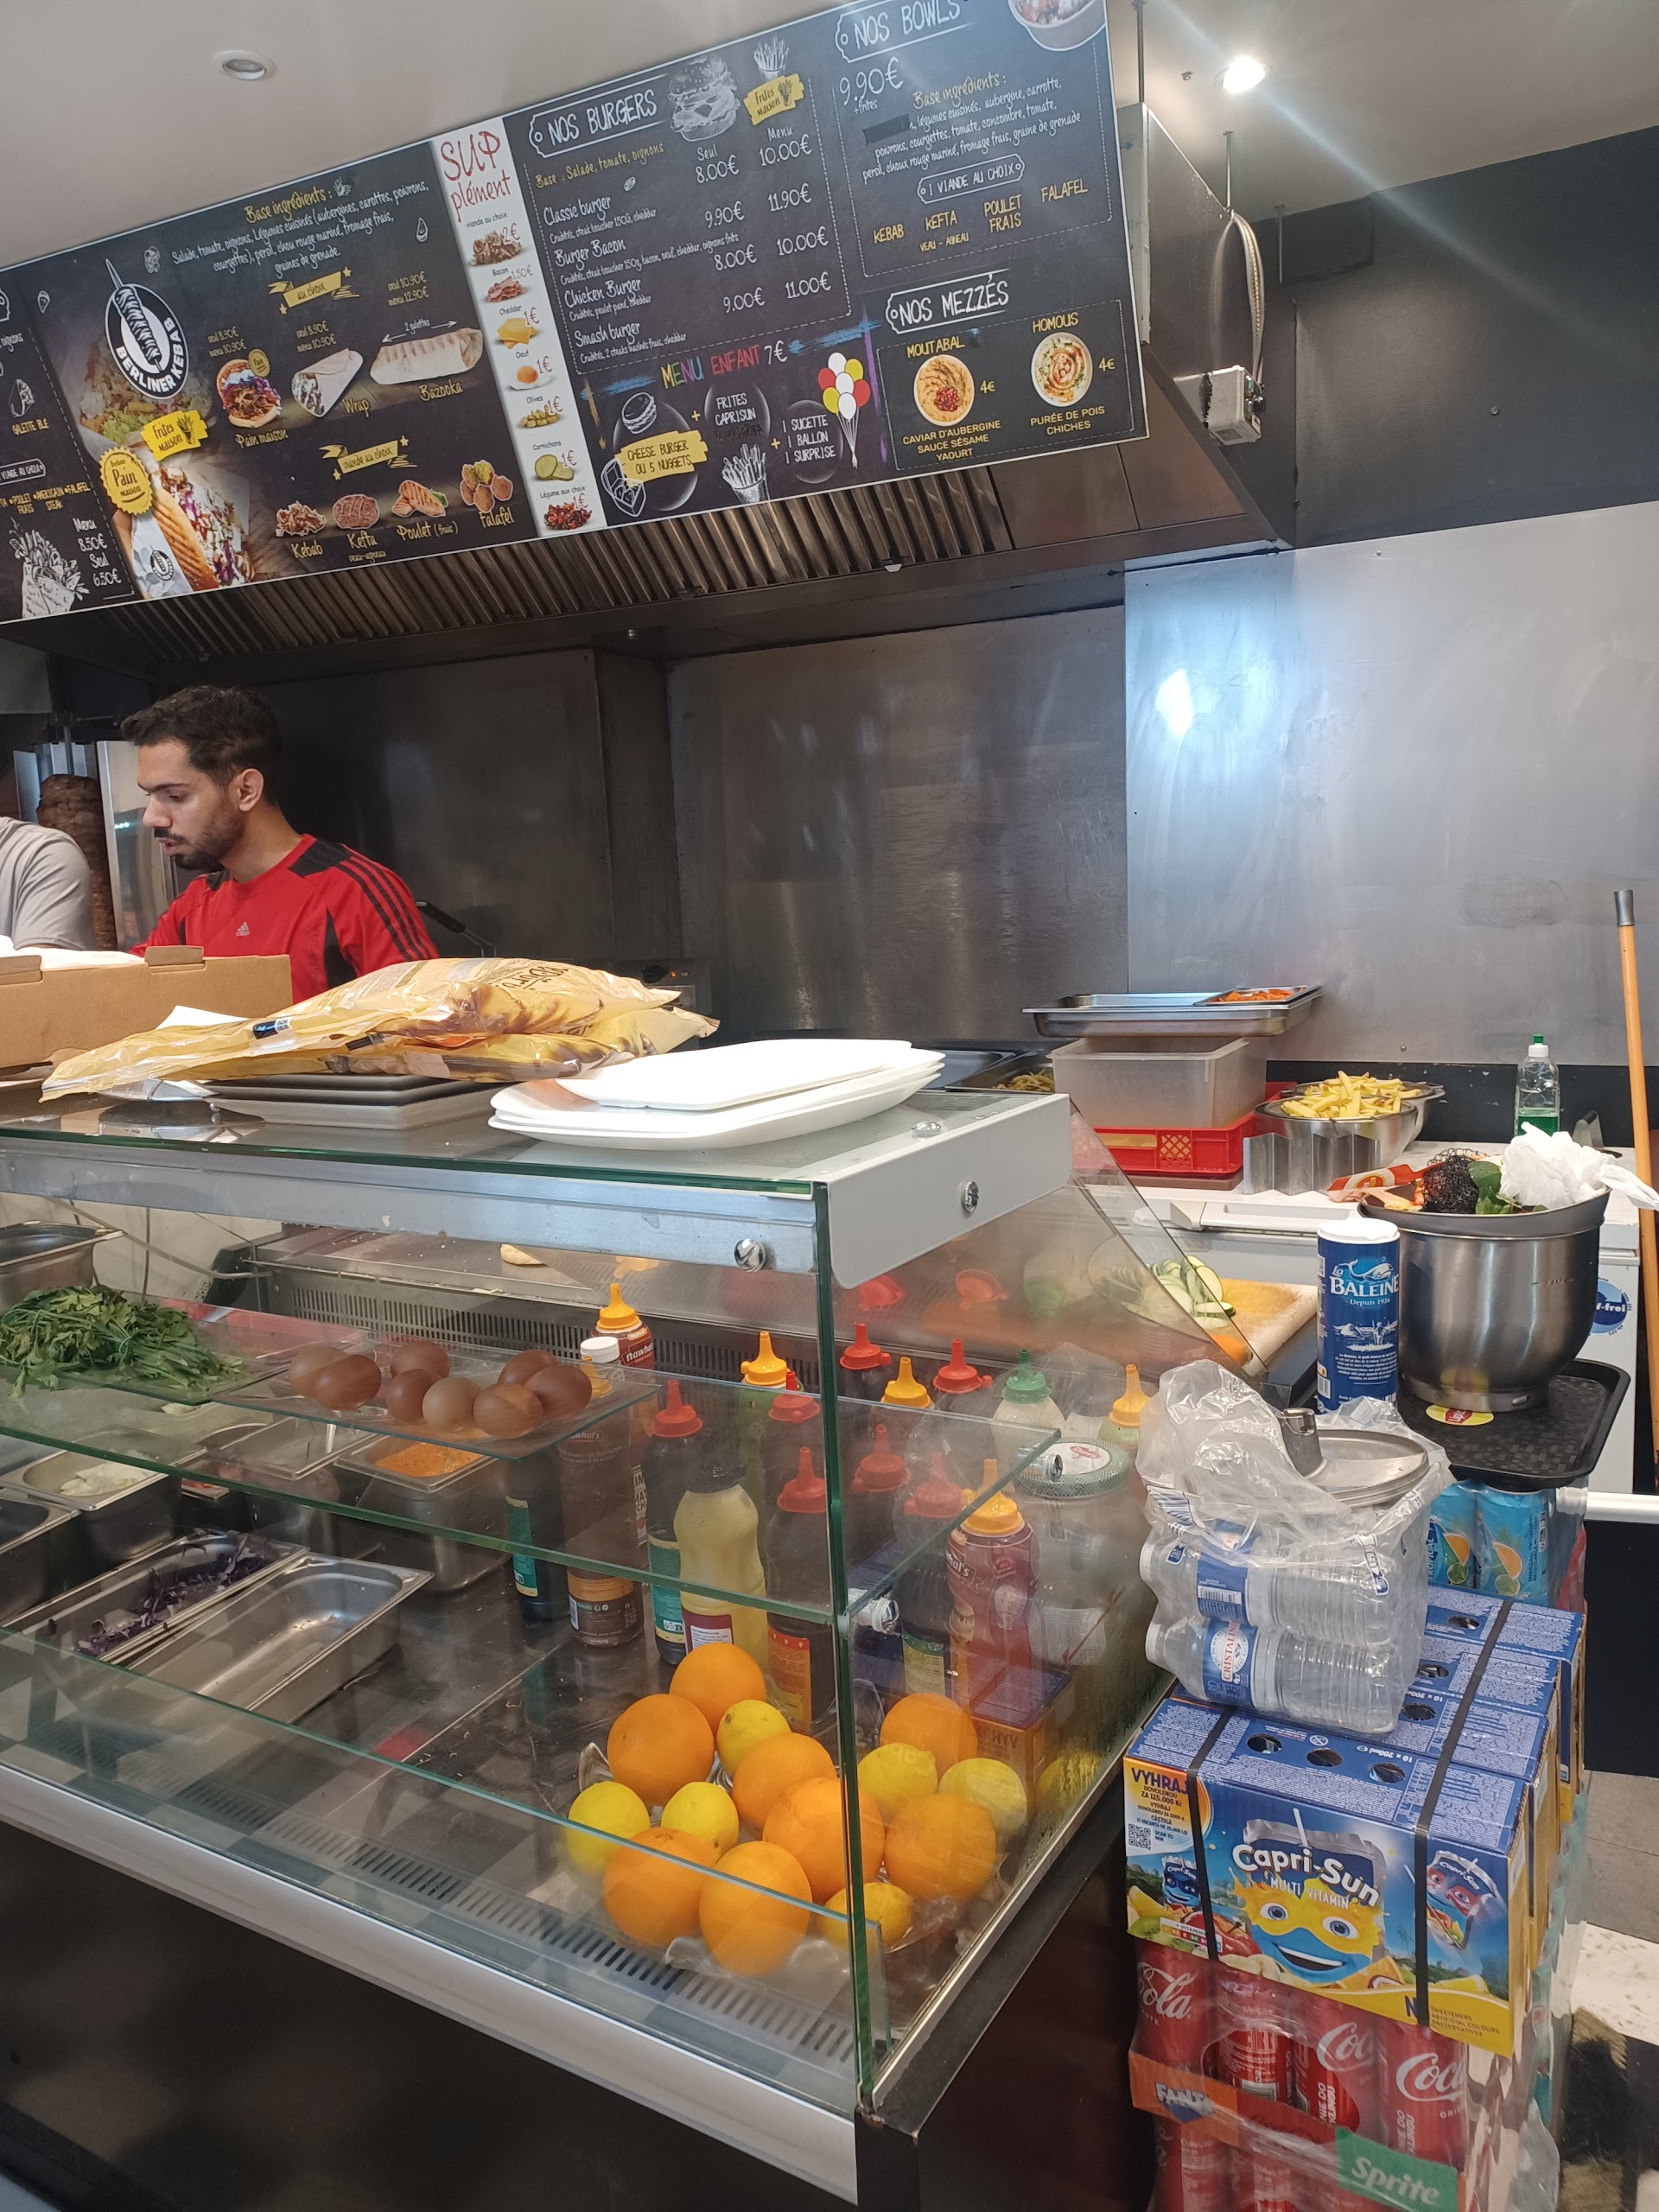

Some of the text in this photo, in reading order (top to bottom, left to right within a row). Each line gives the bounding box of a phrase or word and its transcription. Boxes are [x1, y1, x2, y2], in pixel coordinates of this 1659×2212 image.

[854, 0, 961, 50] NOS BOWLS
[840, 57, 904, 105] 9.90€
[912, 71, 1001, 109] Base ingrédients
[917, 110, 947, 133] légumes
[947, 99, 982, 118] cuisinés,
[985, 87, 1026, 110] aubergine,
[1027, 76, 1062, 96] carrotte,
[548, 89, 657, 145] NOS BURGERS
[909, 98, 1058, 152] courgettes, tomate, concombre, tomate,
[767, 127, 793, 142] Menu
[441, 131, 501, 181] SUP
[695, 133, 812, 183] 8.00€ 10.00€
[697, 143, 718, 162] Seul
[862, 111, 1081, 185] persil, choux rouge fromage frais, graine de grenade
[536, 143, 664, 188] Base Salade, tomate, oignons
[937, 162, 1014, 194] VIANDE AU CHOIX
[451, 169, 512, 223] plément
[1040, 178, 1089, 203] FALAFEL
[245, 186, 327, 223] Base ingrédients
[543, 195, 612, 226] Classic burger
[705, 182, 812, 228] 9.90€ 11.90€
[983, 194, 1022, 217] POULET
[467, 218, 485, 228] viande
[493, 211, 508, 221] choix
[925, 210, 957, 231] KEFTA
[989, 213, 1021, 233] FRAIS
[276, 218, 373, 252] chou rouge fromage
[503, 223, 521, 245] 2€
[874, 224, 905, 244] KEBAB
[172, 235, 254, 264] Salade, tomate, oignons,
[555, 237, 626, 271] Burger Bacon
[714, 226, 830, 271] 8.00€ 10.00€
[275, 253, 309, 279] graines de
[493, 266, 509, 276] Bacon
[307, 282, 328, 299] choix
[564, 278, 641, 308] Chicken Burger
[723, 270, 832, 314] 9.00€ 11.00€
[899, 273, 1009, 327] NOS MEZZÉS
[499, 306, 522, 316] Cheddar
[524, 307, 540, 326] 1€
[404, 321, 410, 332] 2
[1032, 311, 1078, 334] HOMOUS
[574, 321, 641, 347] Smash burger
[116, 316, 185, 392] BERLINER KEBAB
[906, 335, 965, 359] MOUTABAL
[537, 356, 553, 374] 1€
[660, 340, 788, 389] MENU ENFANT 7€
[1099, 358, 1116, 372] 4€
[419, 379, 463, 403] Bazooka
[980, 380, 995, 394] 4€
[343, 397, 370, 418] Wrap
[548, 396, 563, 415] 1€
[715, 392, 748, 411] FRITES
[715, 408, 757, 427] CAPRISUN
[791, 415, 828, 432] SUCETTE
[1030, 405, 1106, 427] PURÉE DE POIS
[154, 420, 175, 441] Frites
[902, 420, 1001, 446] CAVIAR D'AUBERGINE
[1046, 420, 1091, 435] CHICHES
[235, 428, 289, 449] Pain maison
[533, 440, 562, 451] Cornichons
[797, 430, 830, 448] BALLON
[918, 432, 989, 454] SAUCE SÉSAME
[374, 445, 394, 460] choix
[562, 449, 577, 467] 1€
[627, 440, 690, 463] CHEESE BURGER
[793, 446, 836, 463] SURPRISE
[936, 448, 974, 461] YAOURT
[636, 455, 691, 475] OU NUGGETS
[112, 467, 138, 487] Pain
[540, 489, 560, 499] Légume
[574, 493, 588, 510] 1€
[479, 506, 515, 529] Falafel
[347, 531, 378, 550] Kefta
[397, 522, 432, 541] Poulet
[290, 540, 323, 560] Kebab
[1331, 1265, 1344, 1277] La
[1329, 1274, 1400, 1297] BALEINE
[1350, 1298, 1376, 1308] Depuis
[1131, 1767, 1188, 1796] VYHRAJ
[1144, 1785, 1177, 1799] DOVOLENOU
[1150, 1801, 1171, 1812] VYHRAJ
[1151, 1792, 1173, 1805] 125.000
[1166, 1865, 1198, 1880] Capri-Sun
[1232, 1844, 1380, 1907] Capri-Sun
[1440, 1860, 1480, 1891] Capri-Sun
[1431, 2006, 1472, 2021] SWEETENERS
[1431, 2014, 1467, 2029] ARTIFICIAL
[1432, 2020, 1483, 2037] PRESERVATIVES
[1351, 2157, 1440, 2204] Sprite
